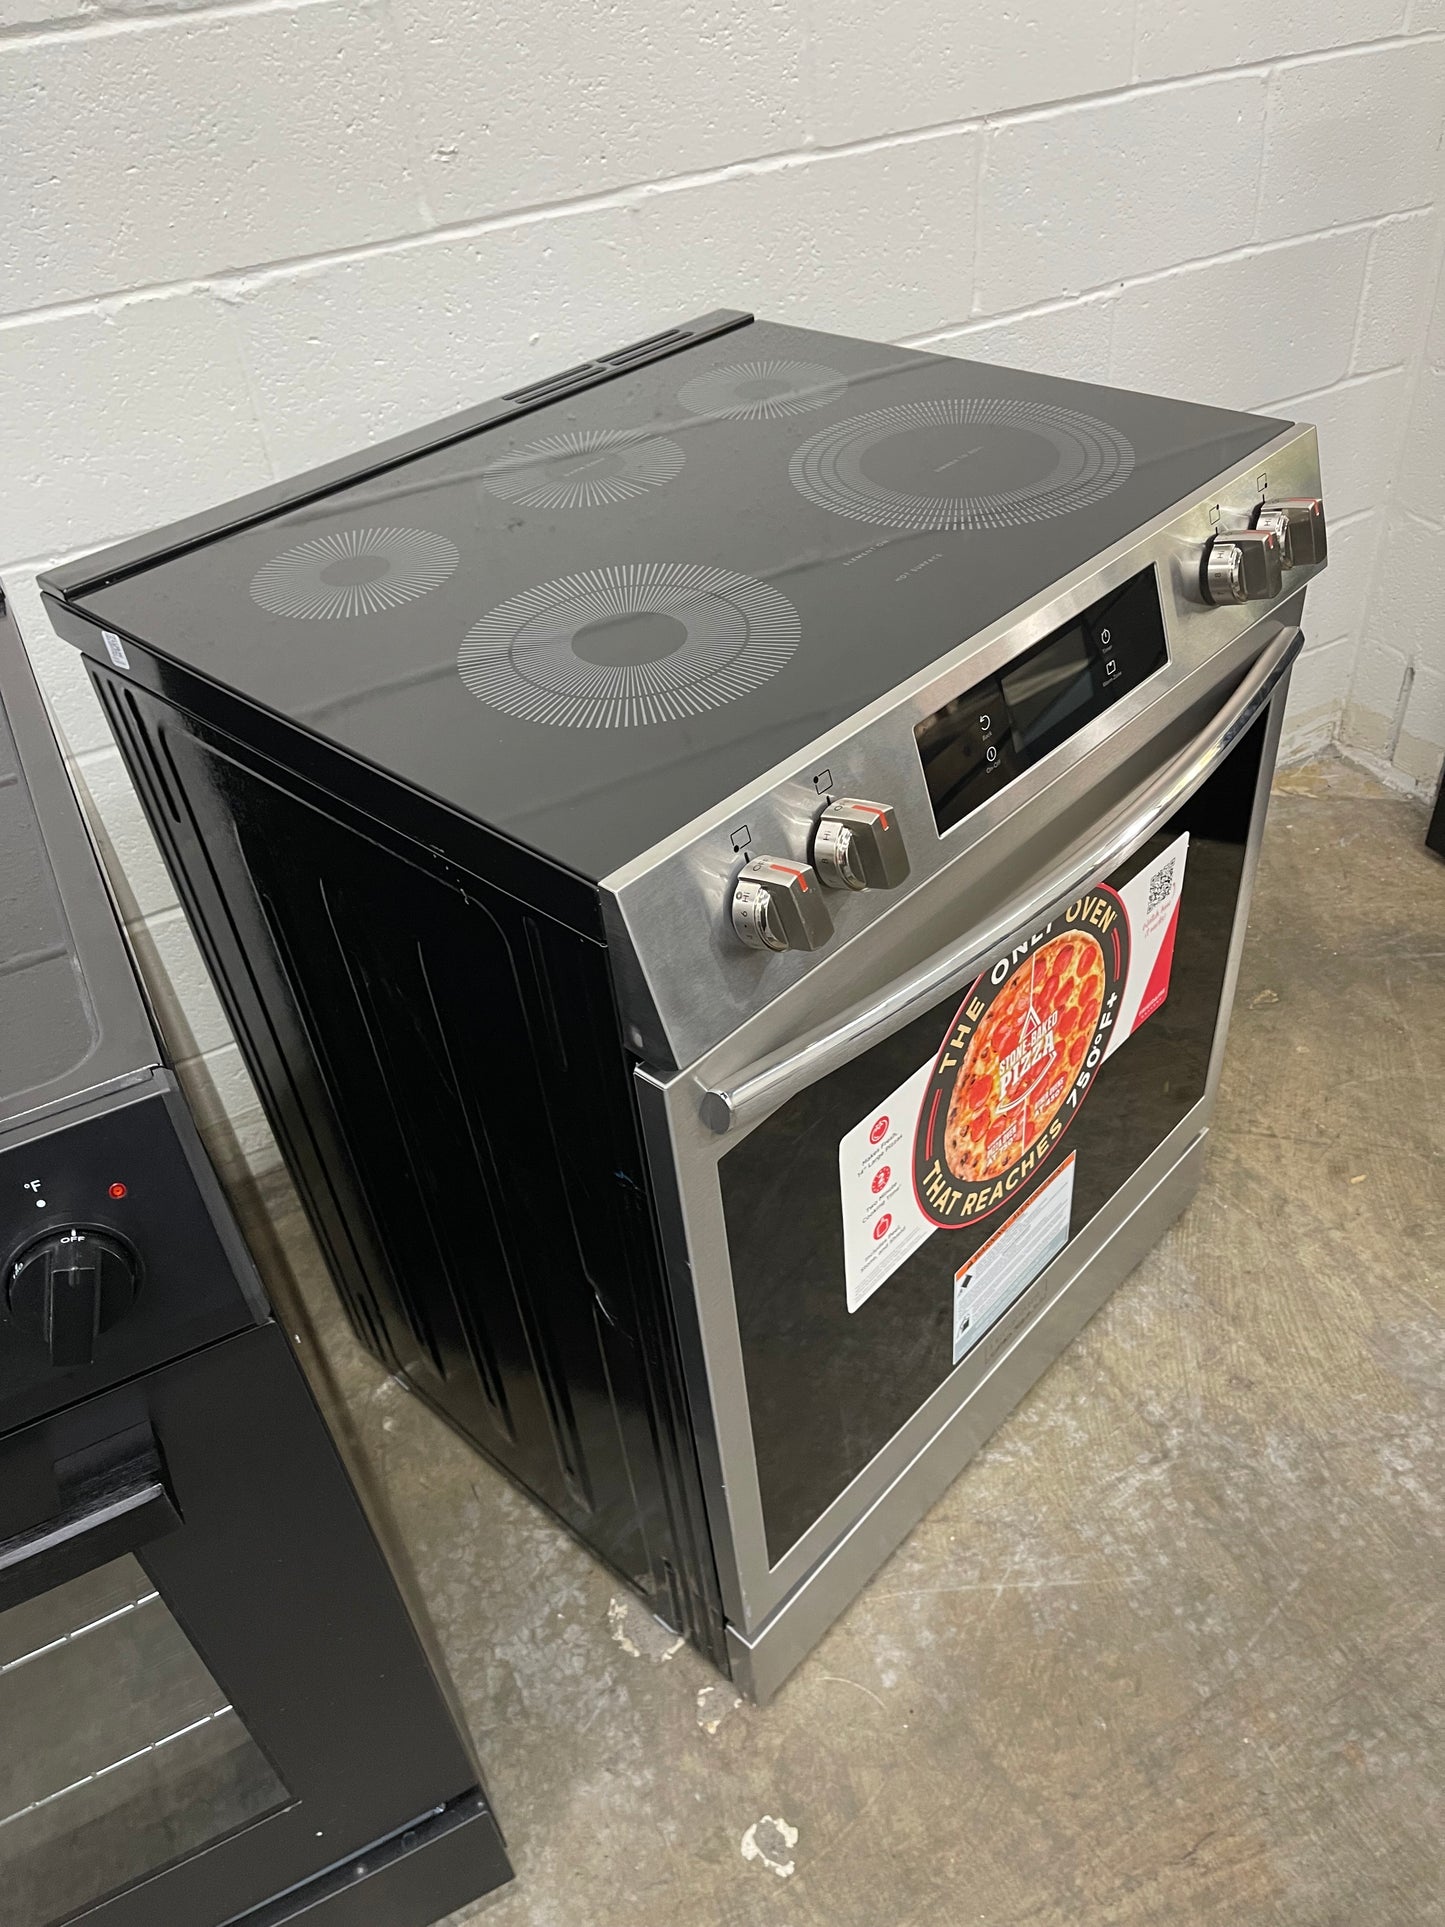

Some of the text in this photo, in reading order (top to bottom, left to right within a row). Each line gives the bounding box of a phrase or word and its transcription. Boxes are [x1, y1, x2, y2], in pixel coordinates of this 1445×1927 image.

[842, 546, 876, 567] ELEMENT
[910, 553, 943, 573] SURFACE
[938, 996, 985, 1074] THE
[1000, 1010, 1060, 1076] STONE-BAKED
[1000, 1030, 1056, 1100] PIZZA
[24, 1180, 41, 1192] °F
[922, 1159, 962, 1216] THAT
[960, 1118, 1063, 1217] REACHES
[60, 1236, 86, 1244] OFF
